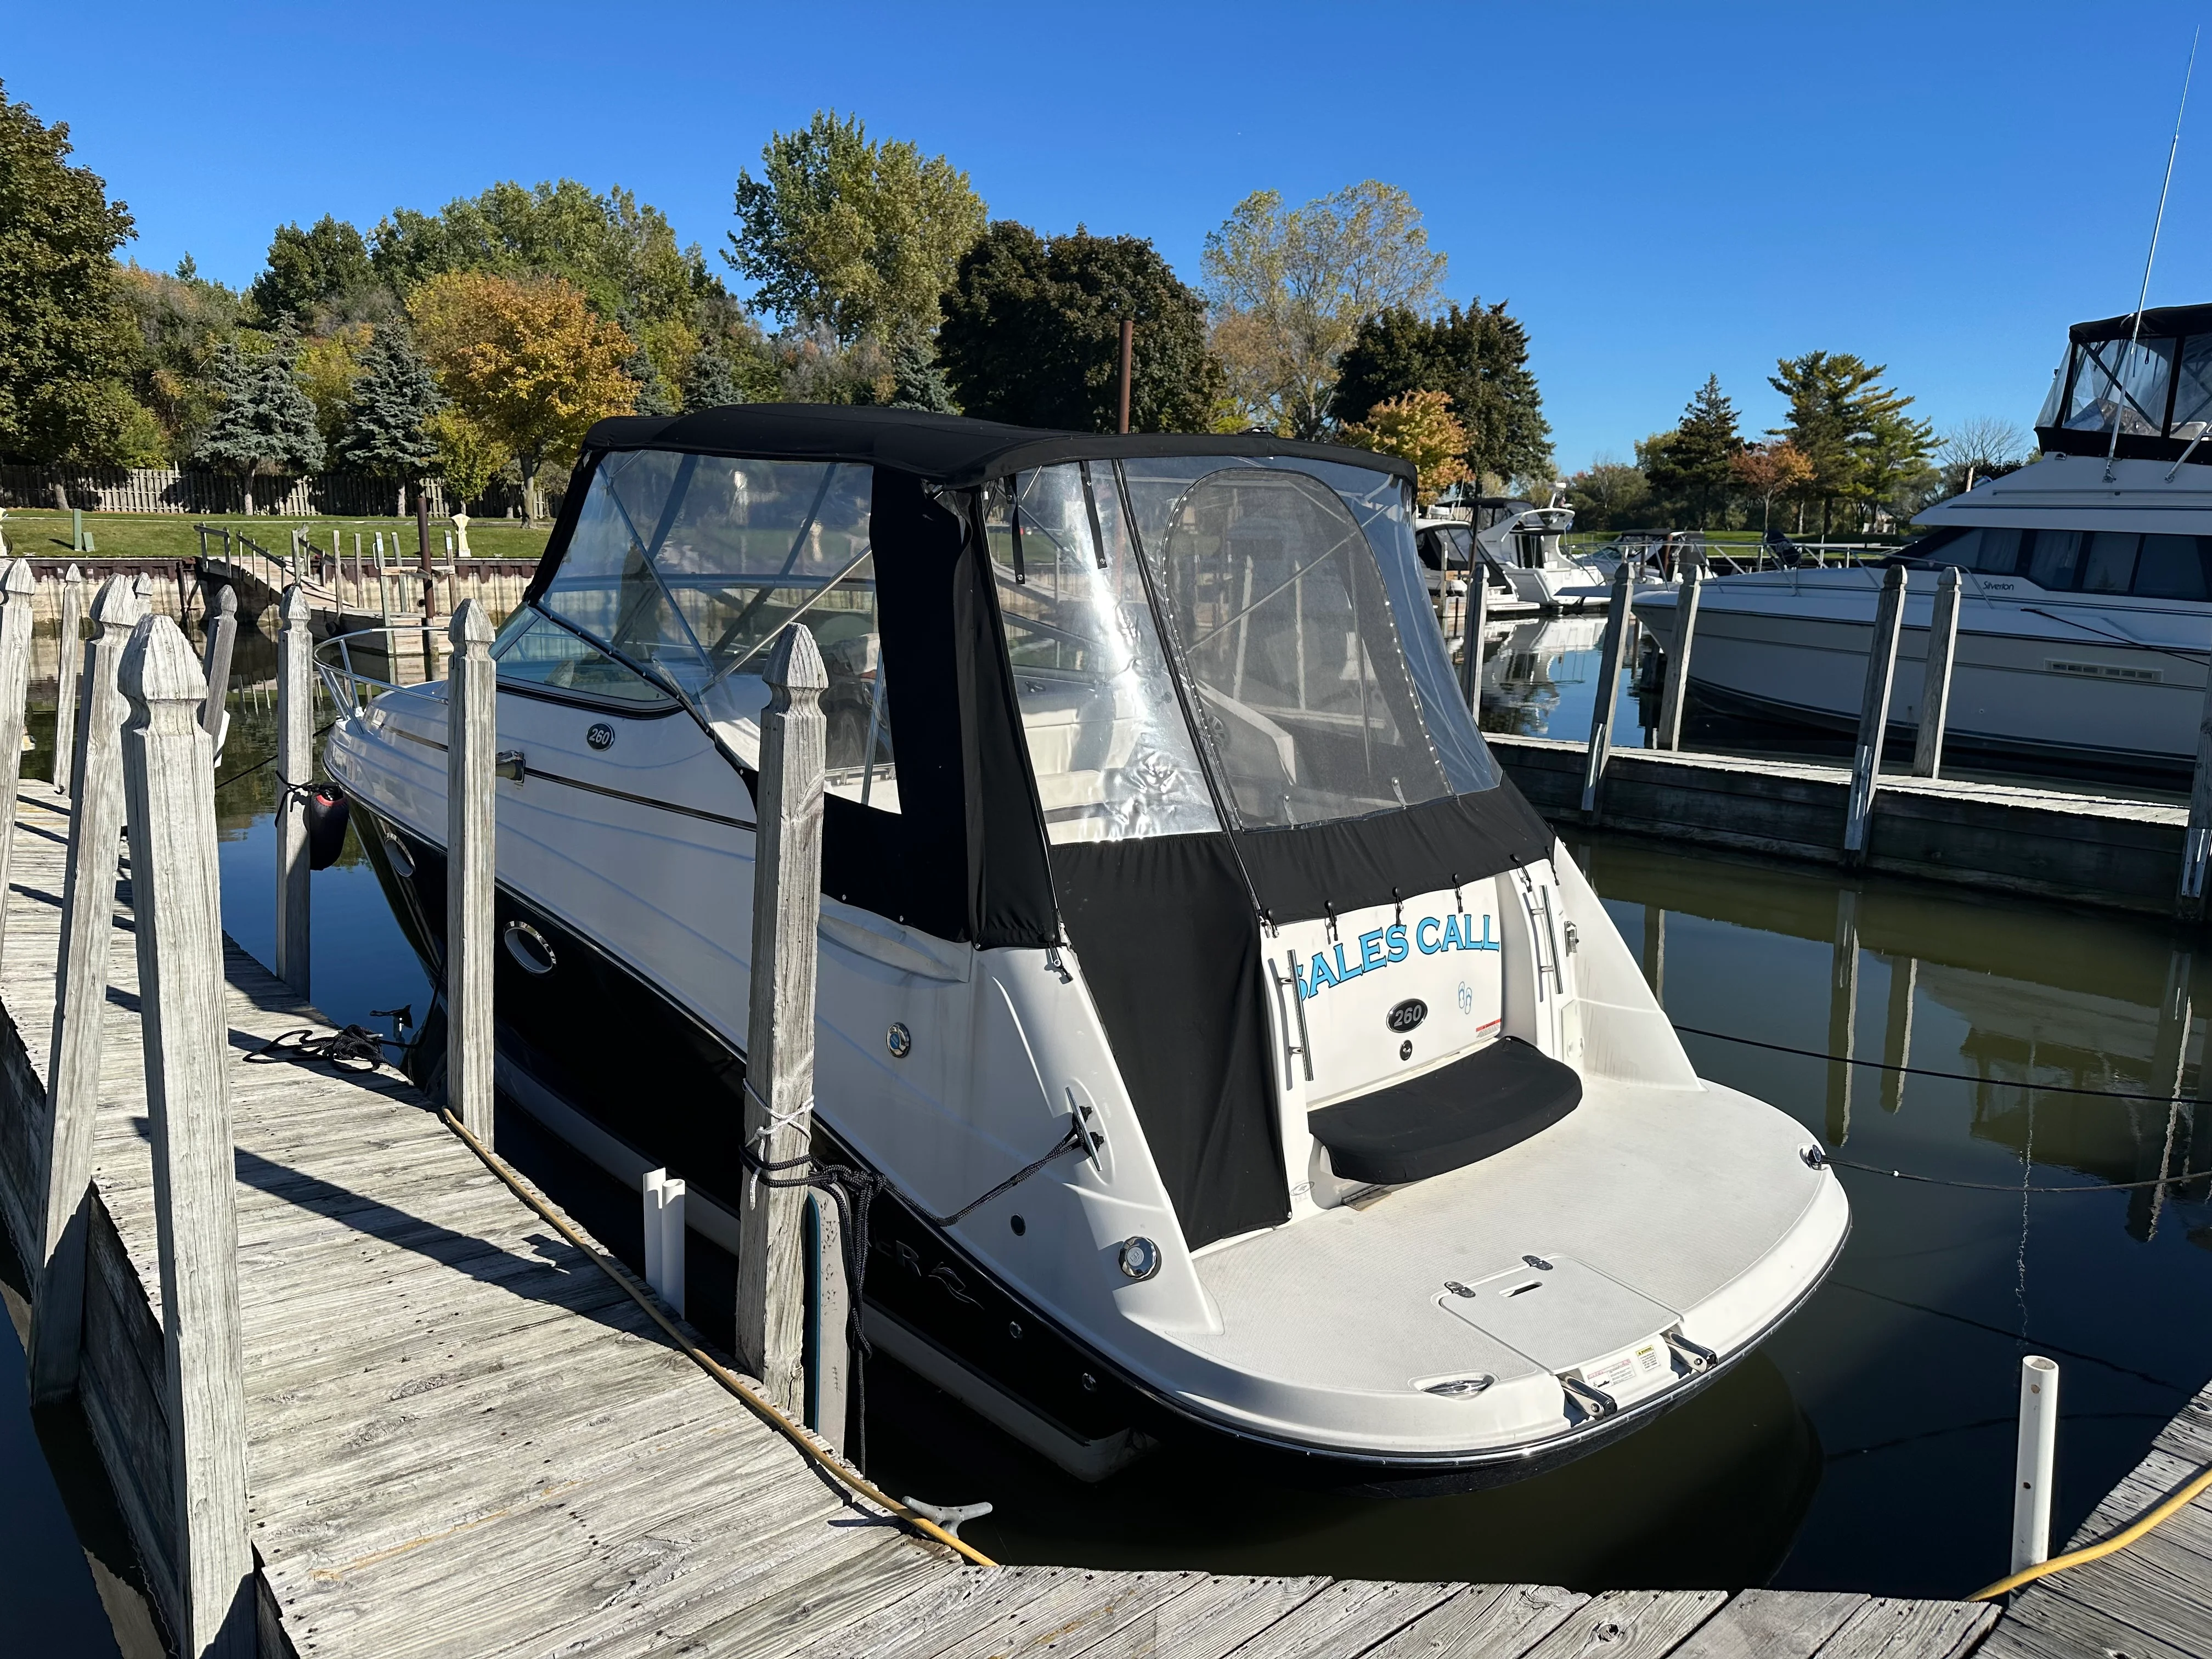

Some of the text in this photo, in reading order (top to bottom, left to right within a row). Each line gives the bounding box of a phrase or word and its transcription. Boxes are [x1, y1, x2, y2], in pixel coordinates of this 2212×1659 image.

[1983, 581, 2014, 590] Silverton
[589, 728, 610, 744] 260
[1416, 914, 1500, 955] CALL
[1393, 1005, 1422, 1027] 260
